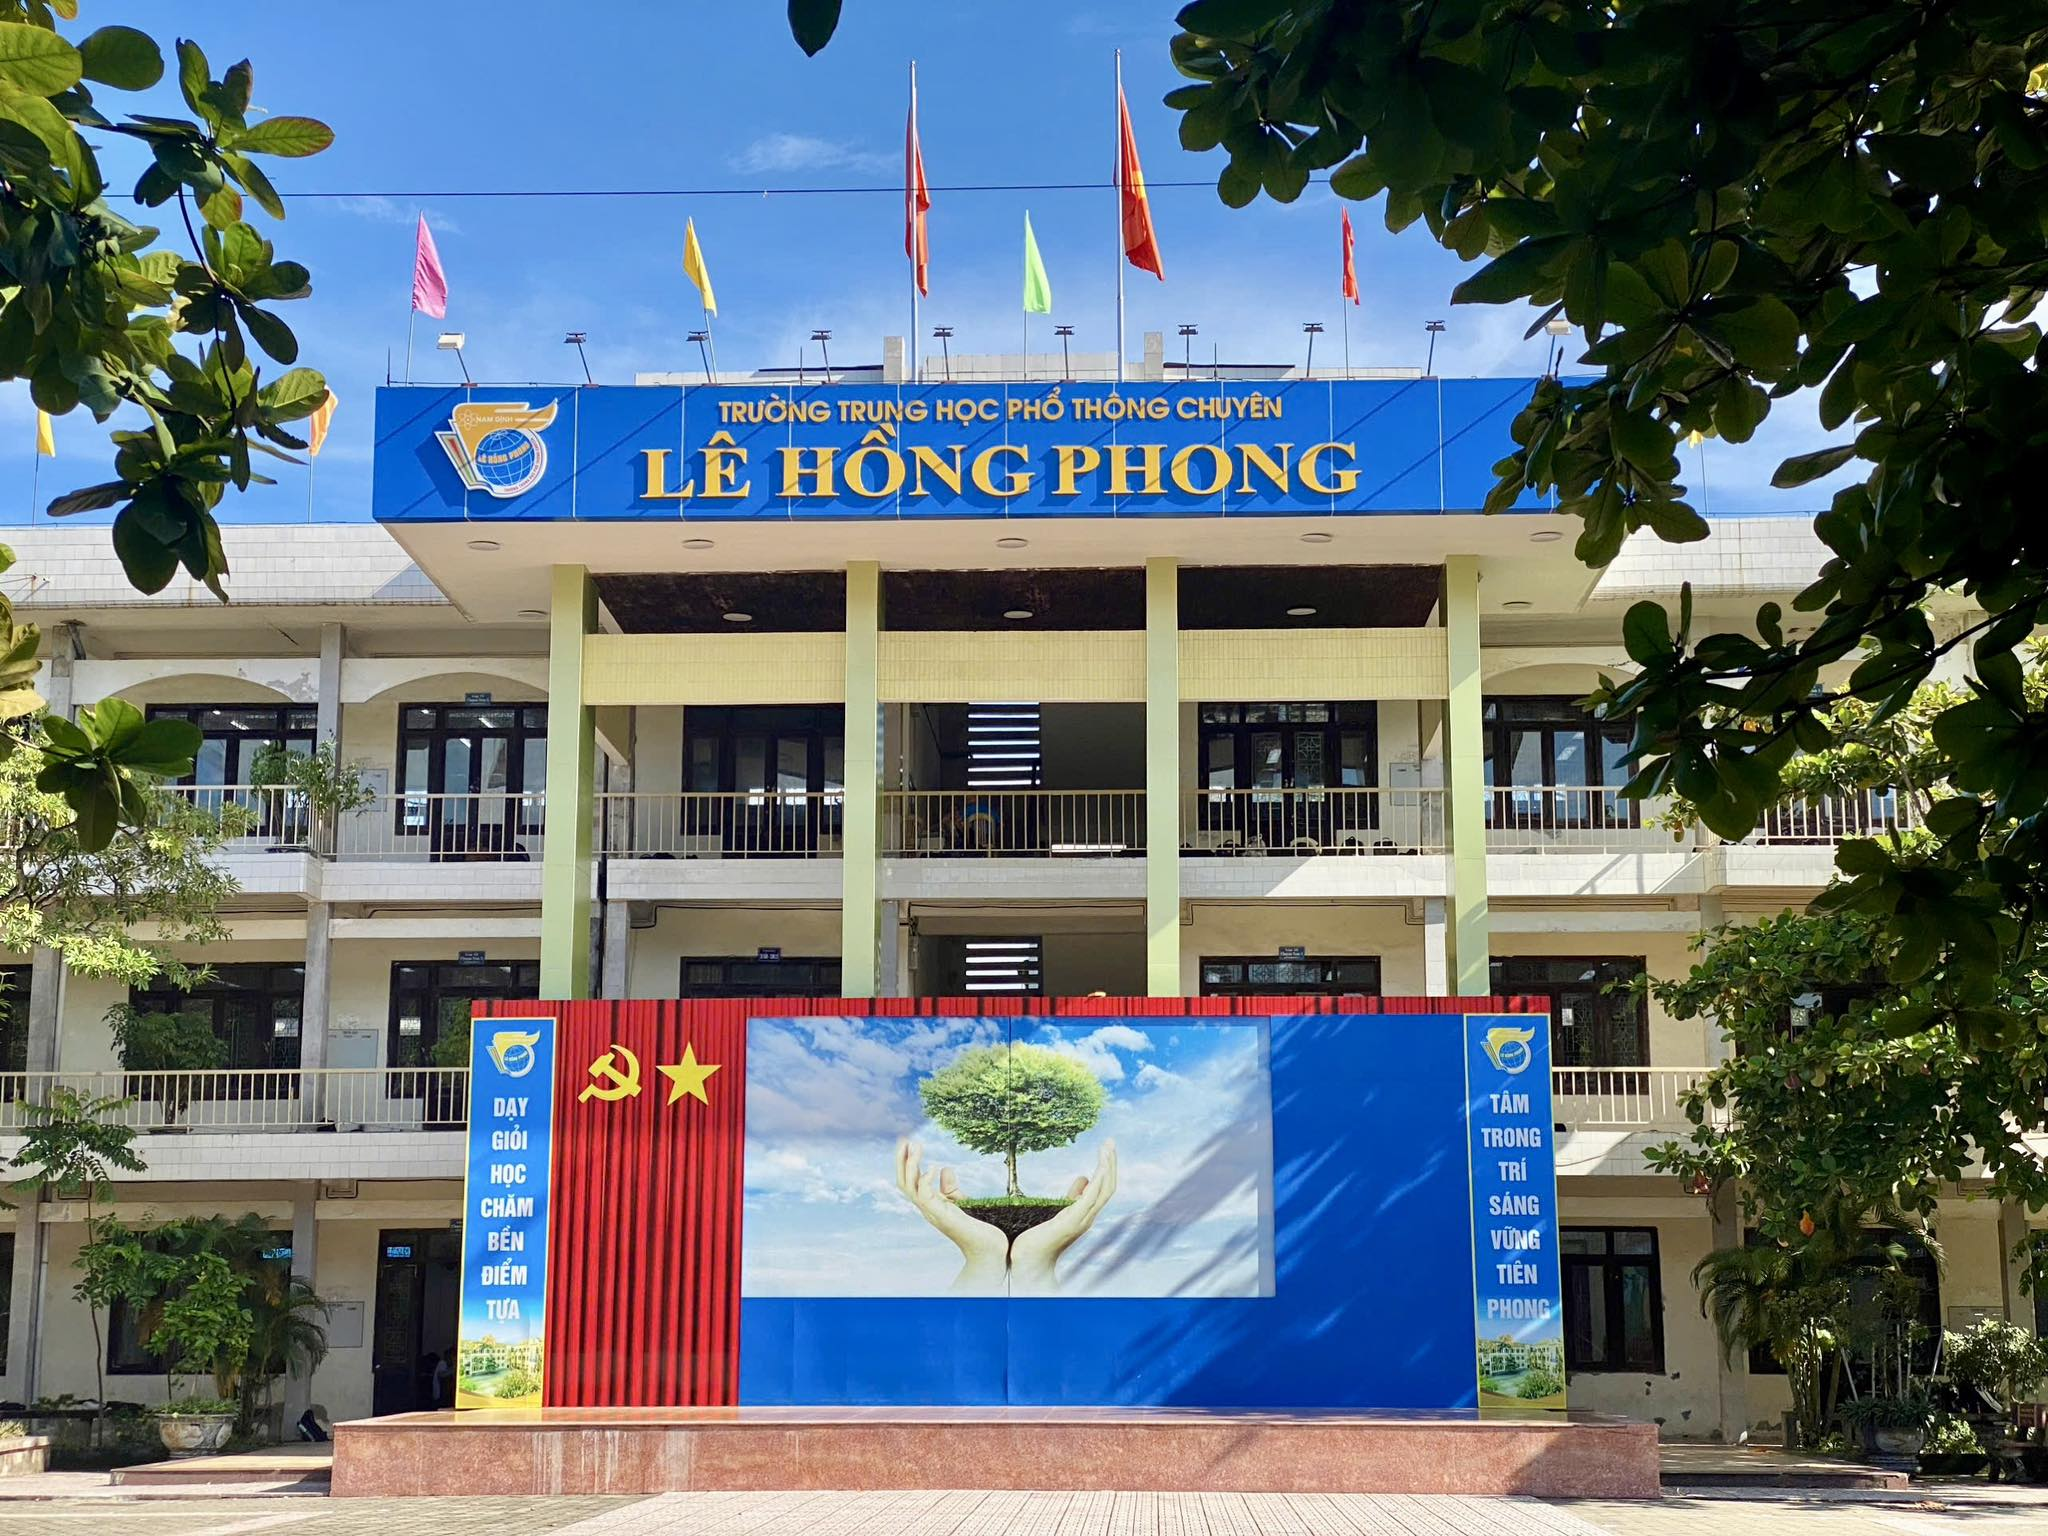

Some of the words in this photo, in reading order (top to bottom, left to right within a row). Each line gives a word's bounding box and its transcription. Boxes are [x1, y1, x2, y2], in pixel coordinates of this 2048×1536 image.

[718, 393, 831, 423] TRƯỜNG
[838, 400, 928, 422] TRUNG
[936, 399, 999, 426] HỌC
[1008, 387, 1065, 420] PHỔ
[1072, 395, 1170, 420] THÔNG
[1178, 391, 1283, 419] CHUYÊN
[640, 431, 750, 498] LÊ
[776, 422, 1036, 498] HỒNG
[1052, 440, 1363, 497] PHONG
[493, 1097, 528, 1122] DẠY
[1489, 1090, 1530, 1114] TÂM
[491, 1124, 528, 1151] GIỎI
[1481, 1127, 1541, 1148] TRONG
[490, 1163, 527, 1190] HỌC
[1498, 1157, 1527, 1182] TRÍ
[480, 1193, 534, 1218] CHĂM
[1489, 1191, 1540, 1216] SÁNG
[487, 1225, 525, 1252] BỀN
[1490, 1226, 1541, 1250] VỮNG
[481, 1257, 528, 1286] ĐIỂM
[1496, 1260, 1538, 1284] TIÊN
[486, 1297, 520, 1324] TỰA
[1487, 1298, 1551, 1320] PHONG
